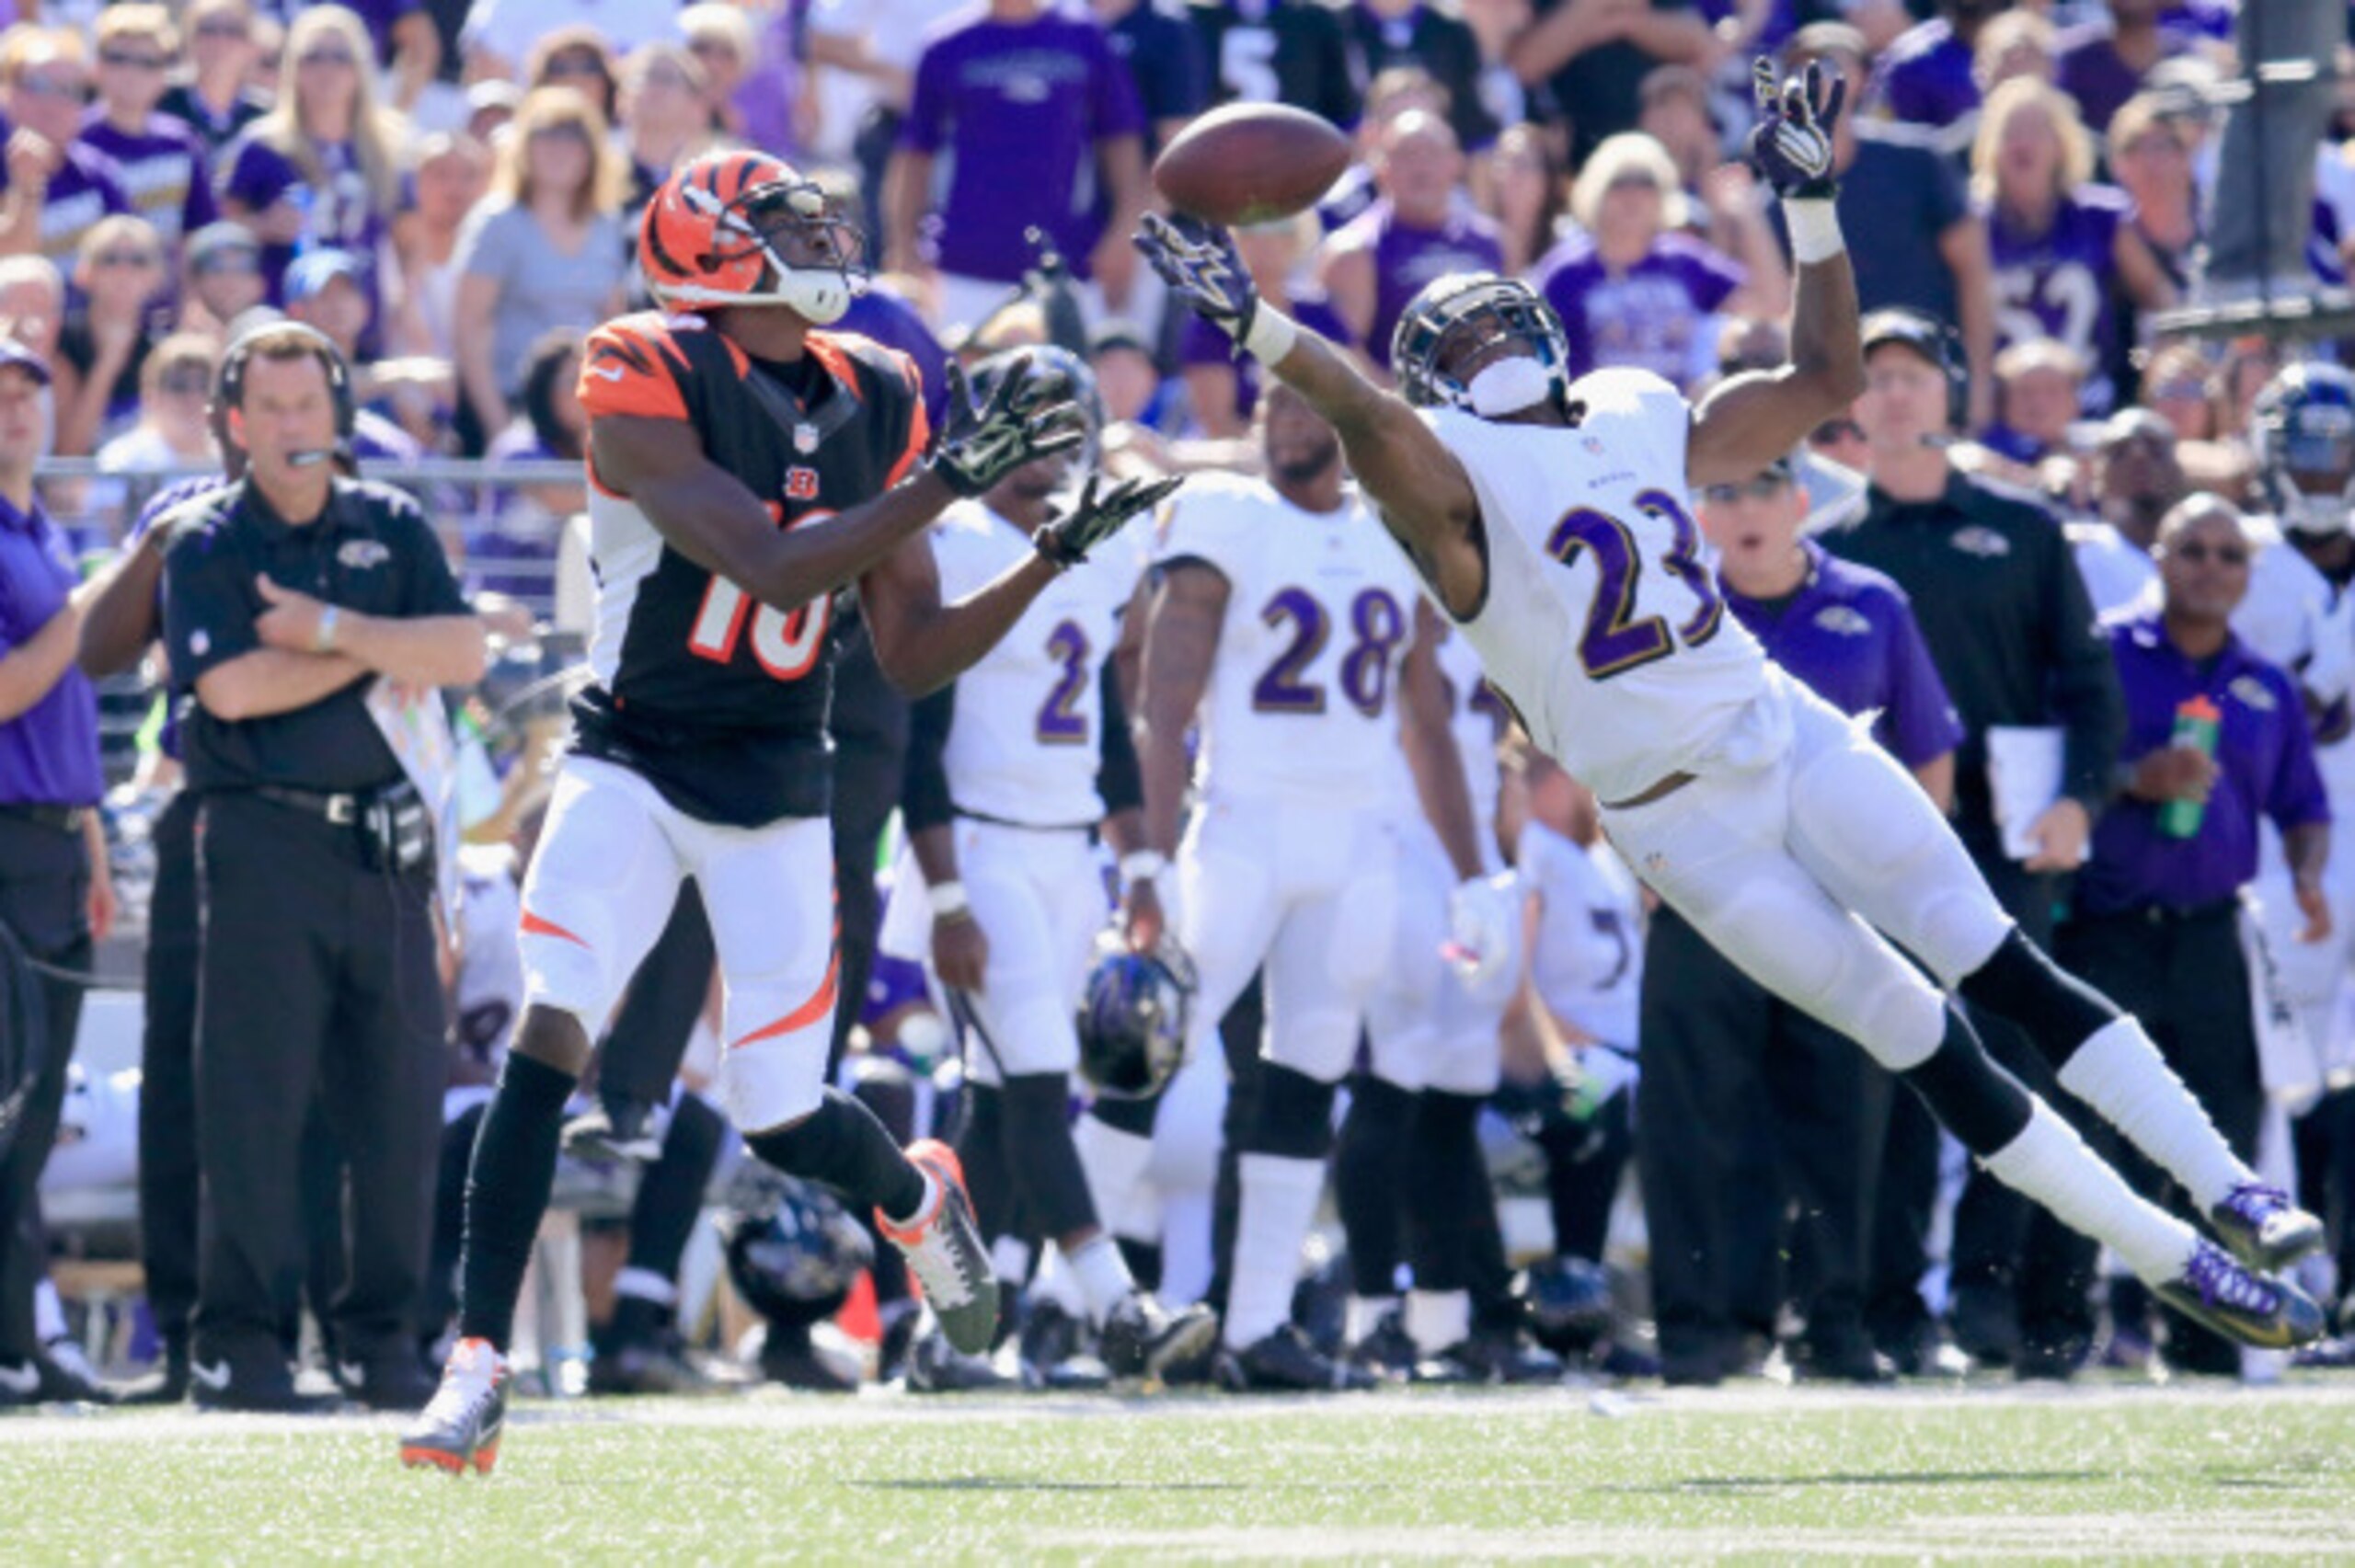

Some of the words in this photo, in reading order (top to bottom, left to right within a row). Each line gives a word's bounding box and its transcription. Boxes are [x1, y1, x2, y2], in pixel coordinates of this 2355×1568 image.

[1220, 28, 1280, 104] 5
[1545, 487, 1724, 681] 23
[1036, 617, 1092, 746] 2
[1252, 586, 1405, 719] 28
